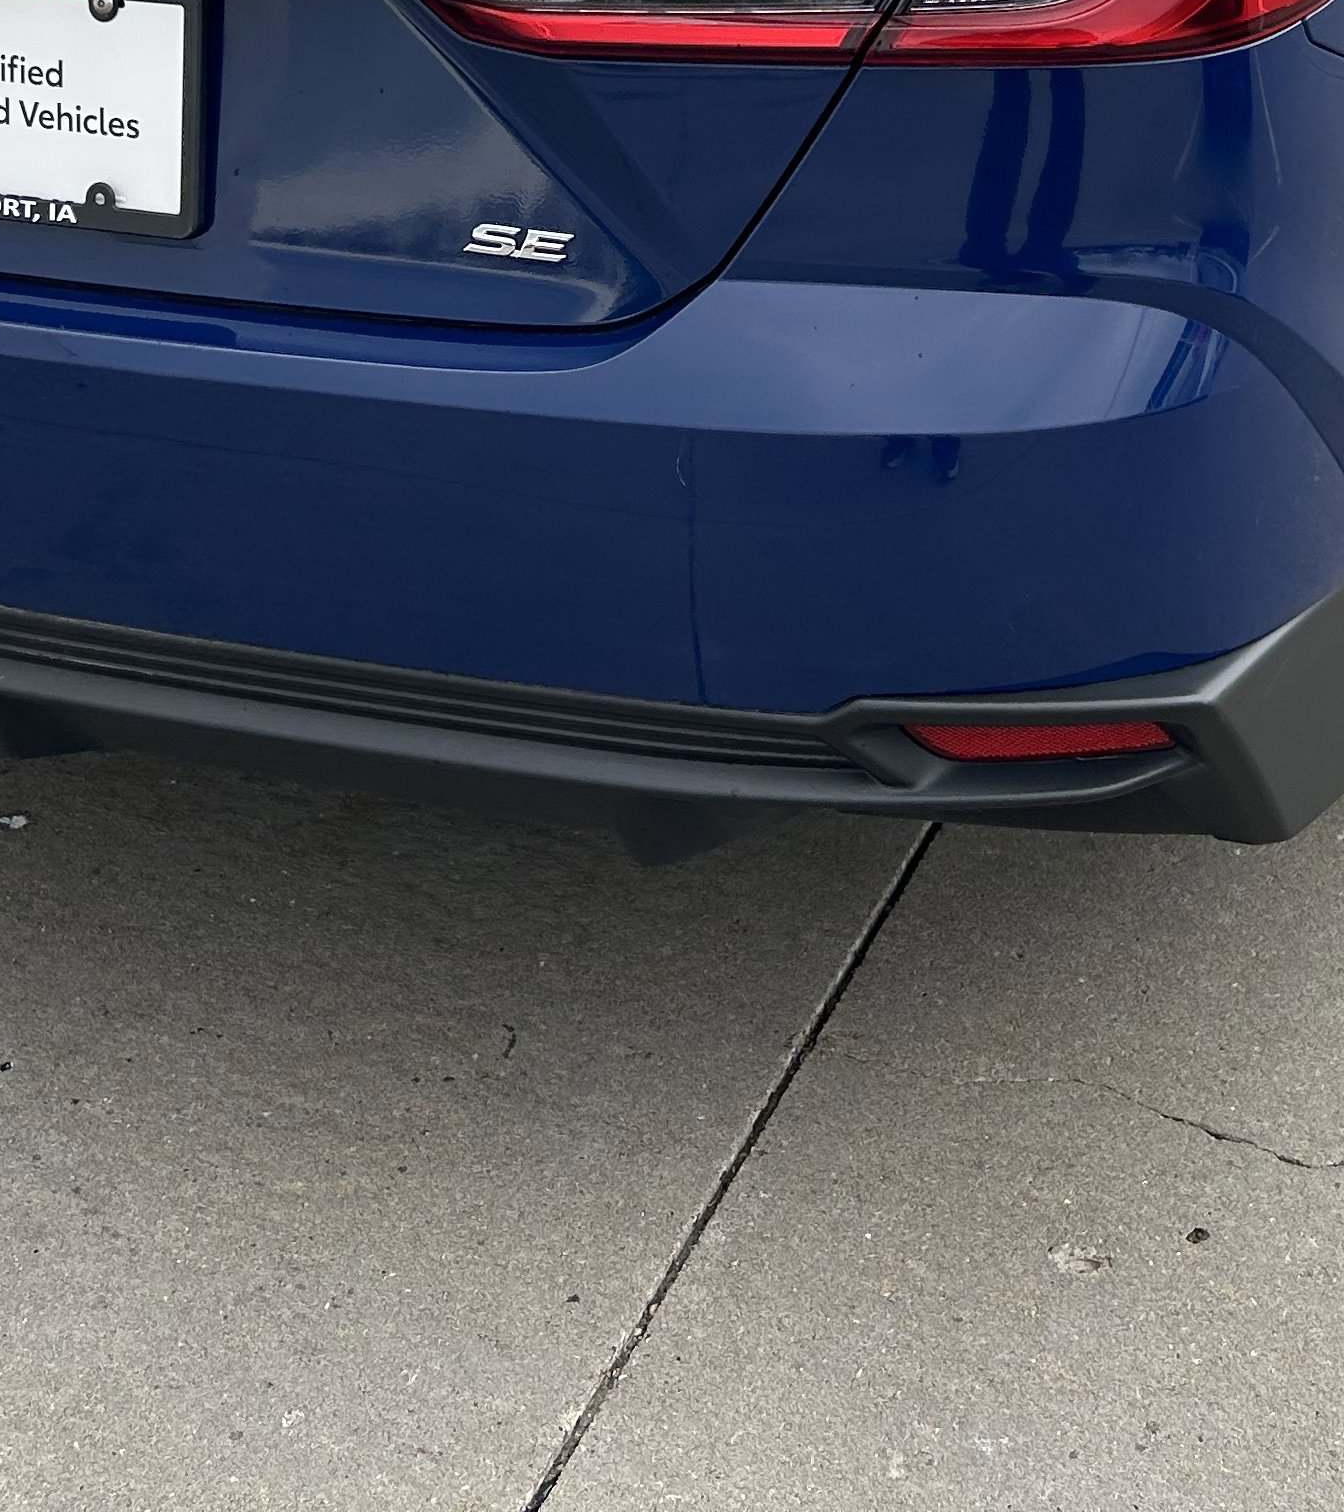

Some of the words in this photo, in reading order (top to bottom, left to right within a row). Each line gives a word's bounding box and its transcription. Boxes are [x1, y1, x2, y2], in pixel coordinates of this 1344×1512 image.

[18, 99, 140, 139] Vehicles
[48, 202, 78, 224] IA
[462, 223, 575, 263] SE
